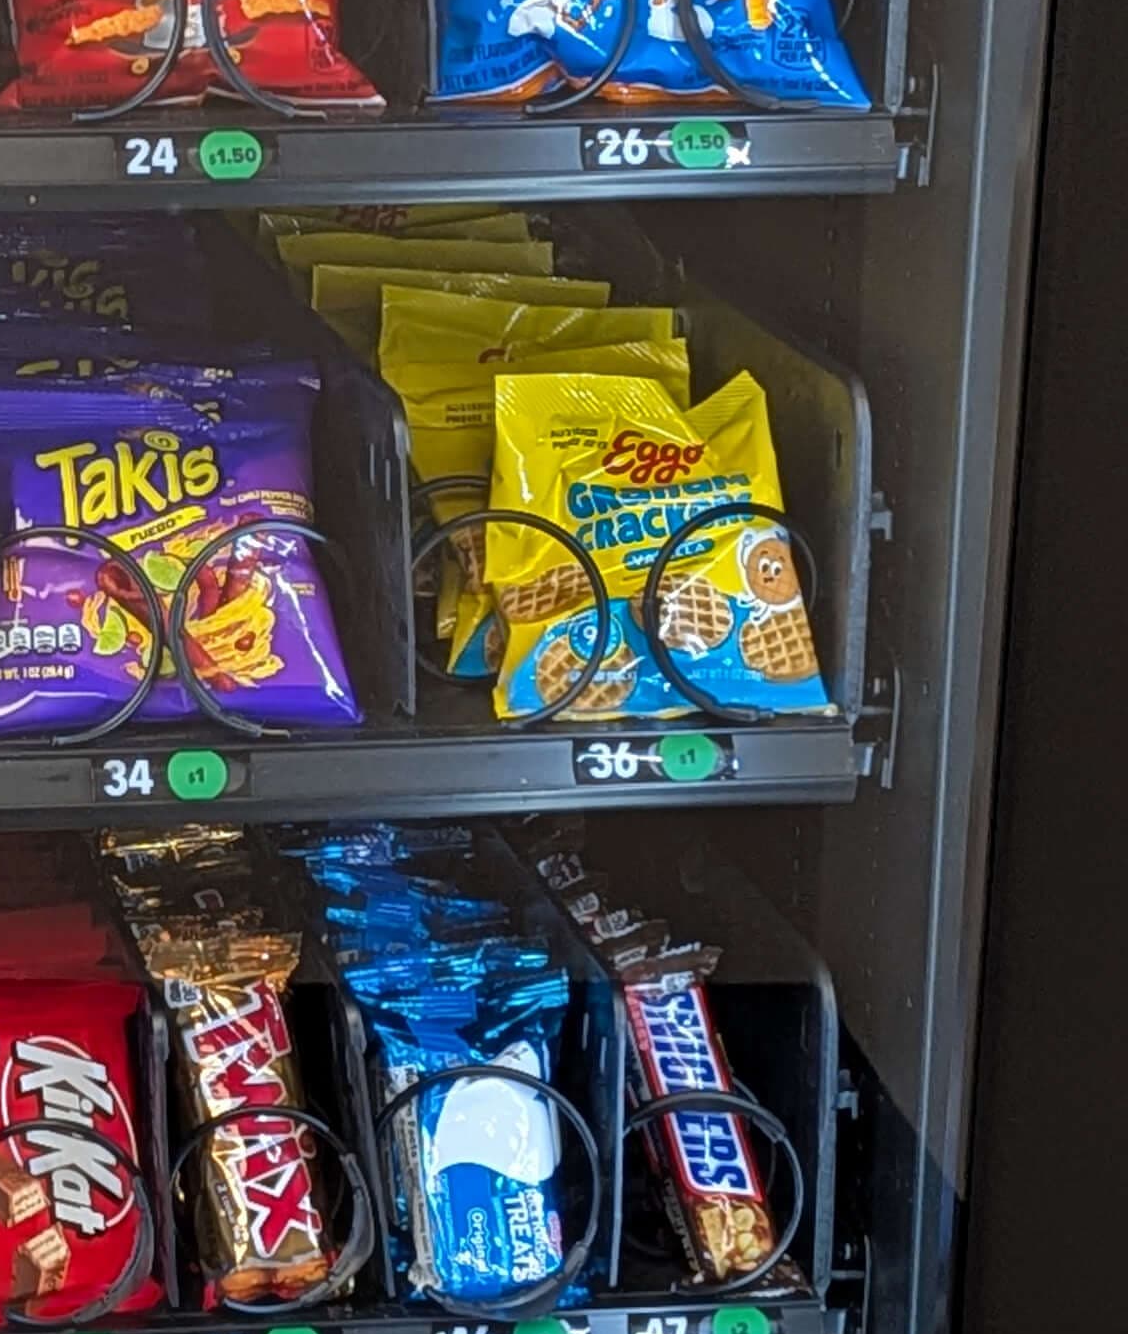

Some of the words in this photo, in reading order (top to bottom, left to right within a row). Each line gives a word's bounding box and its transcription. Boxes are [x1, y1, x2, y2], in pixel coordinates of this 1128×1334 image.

[126, 138, 178, 175] 24
[209, 148, 258, 165] $1.50
[596, 128, 649, 166] 26
[678, 134, 725, 151] $1.50
[602, 430, 706, 484] Eggo
[35, 429, 219, 545] Takis
[583, 624, 598, 645] 9
[589, 743, 638, 778] 36
[680, 748, 697, 766] $1
[103, 759, 154, 795] 34
[187, 767, 207, 785] $1
